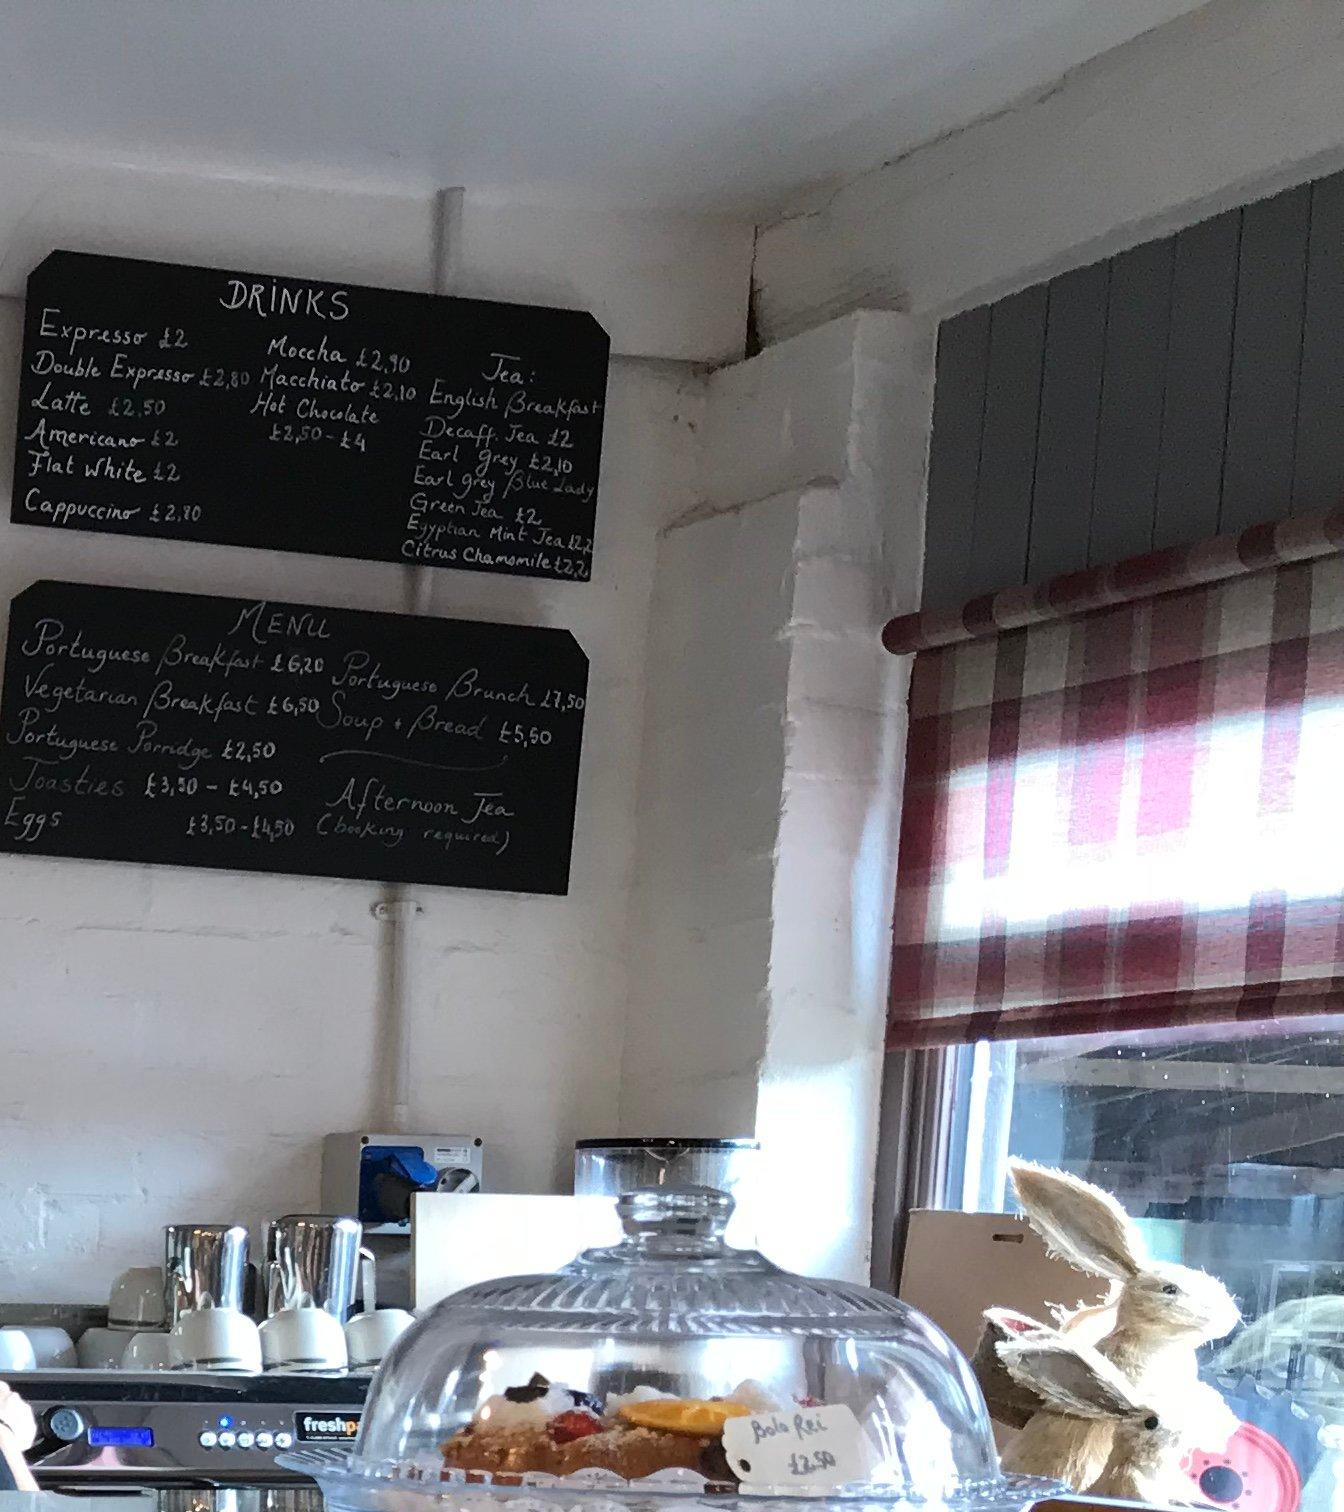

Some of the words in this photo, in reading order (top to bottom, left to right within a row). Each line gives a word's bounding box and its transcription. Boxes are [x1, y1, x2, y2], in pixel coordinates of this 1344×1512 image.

[40, 308, 148, 356] Expresso
[159, 328, 189, 350] £2
[267, 335, 348, 363] Moccha
[31, 350, 102, 378] Double
[110, 353, 196, 390] Expresso
[259, 363, 365, 393] Macchiato
[31, 382, 92, 416] Latte
[249, 392, 287, 416] Hot
[296, 398, 380, 425] Chocolate
[429, 378, 499, 421] English
[504, 389, 603, 422] Breakfast
[24, 418, 146, 450] Americano
[150, 430, 179, 448] £2
[418, 439, 459, 463] Earl
[505, 423, 540, 446] Tea
[547, 428, 575, 449] £2
[28, 450, 74, 476] Flat
[153, 461, 181, 482] £2
[414, 465, 454, 486] Earl
[502, 469, 549, 499] Blue
[553, 477, 596, 503] Lady
[25, 487, 142, 524] Cappuccino
[410, 492, 466, 515] Green
[472, 500, 504, 519] Tea
[515, 506, 543, 526] £2
[407, 513, 482, 543] Egyptian
[489, 525, 529, 541] Mint
[532, 527, 566, 550] Tea
[401, 540, 458, 561] Citrus
[463, 547, 553, 570] Chamomile
[228, 601, 331, 644] MENU
[21, 618, 152, 673] Portuguese
[154, 634, 264, 678] Breakfast
[24, 663, 139, 713] Vegetarian
[142, 680, 260, 722] Breakfast
[331, 650, 439, 700] Portuguese
[445, 668, 537, 708] Brunch
[315, 690, 385, 741] Soup
[406, 705, 487, 740] Bread
[6, 707, 118, 760] Portuguese
[127, 720, 214, 770] Porridge
[9, 755, 126, 797] Toasties
[4, 796, 64, 842] Eggs
[325, 777, 459, 820] Afternoon
[461, 792, 516, 824] Tea
